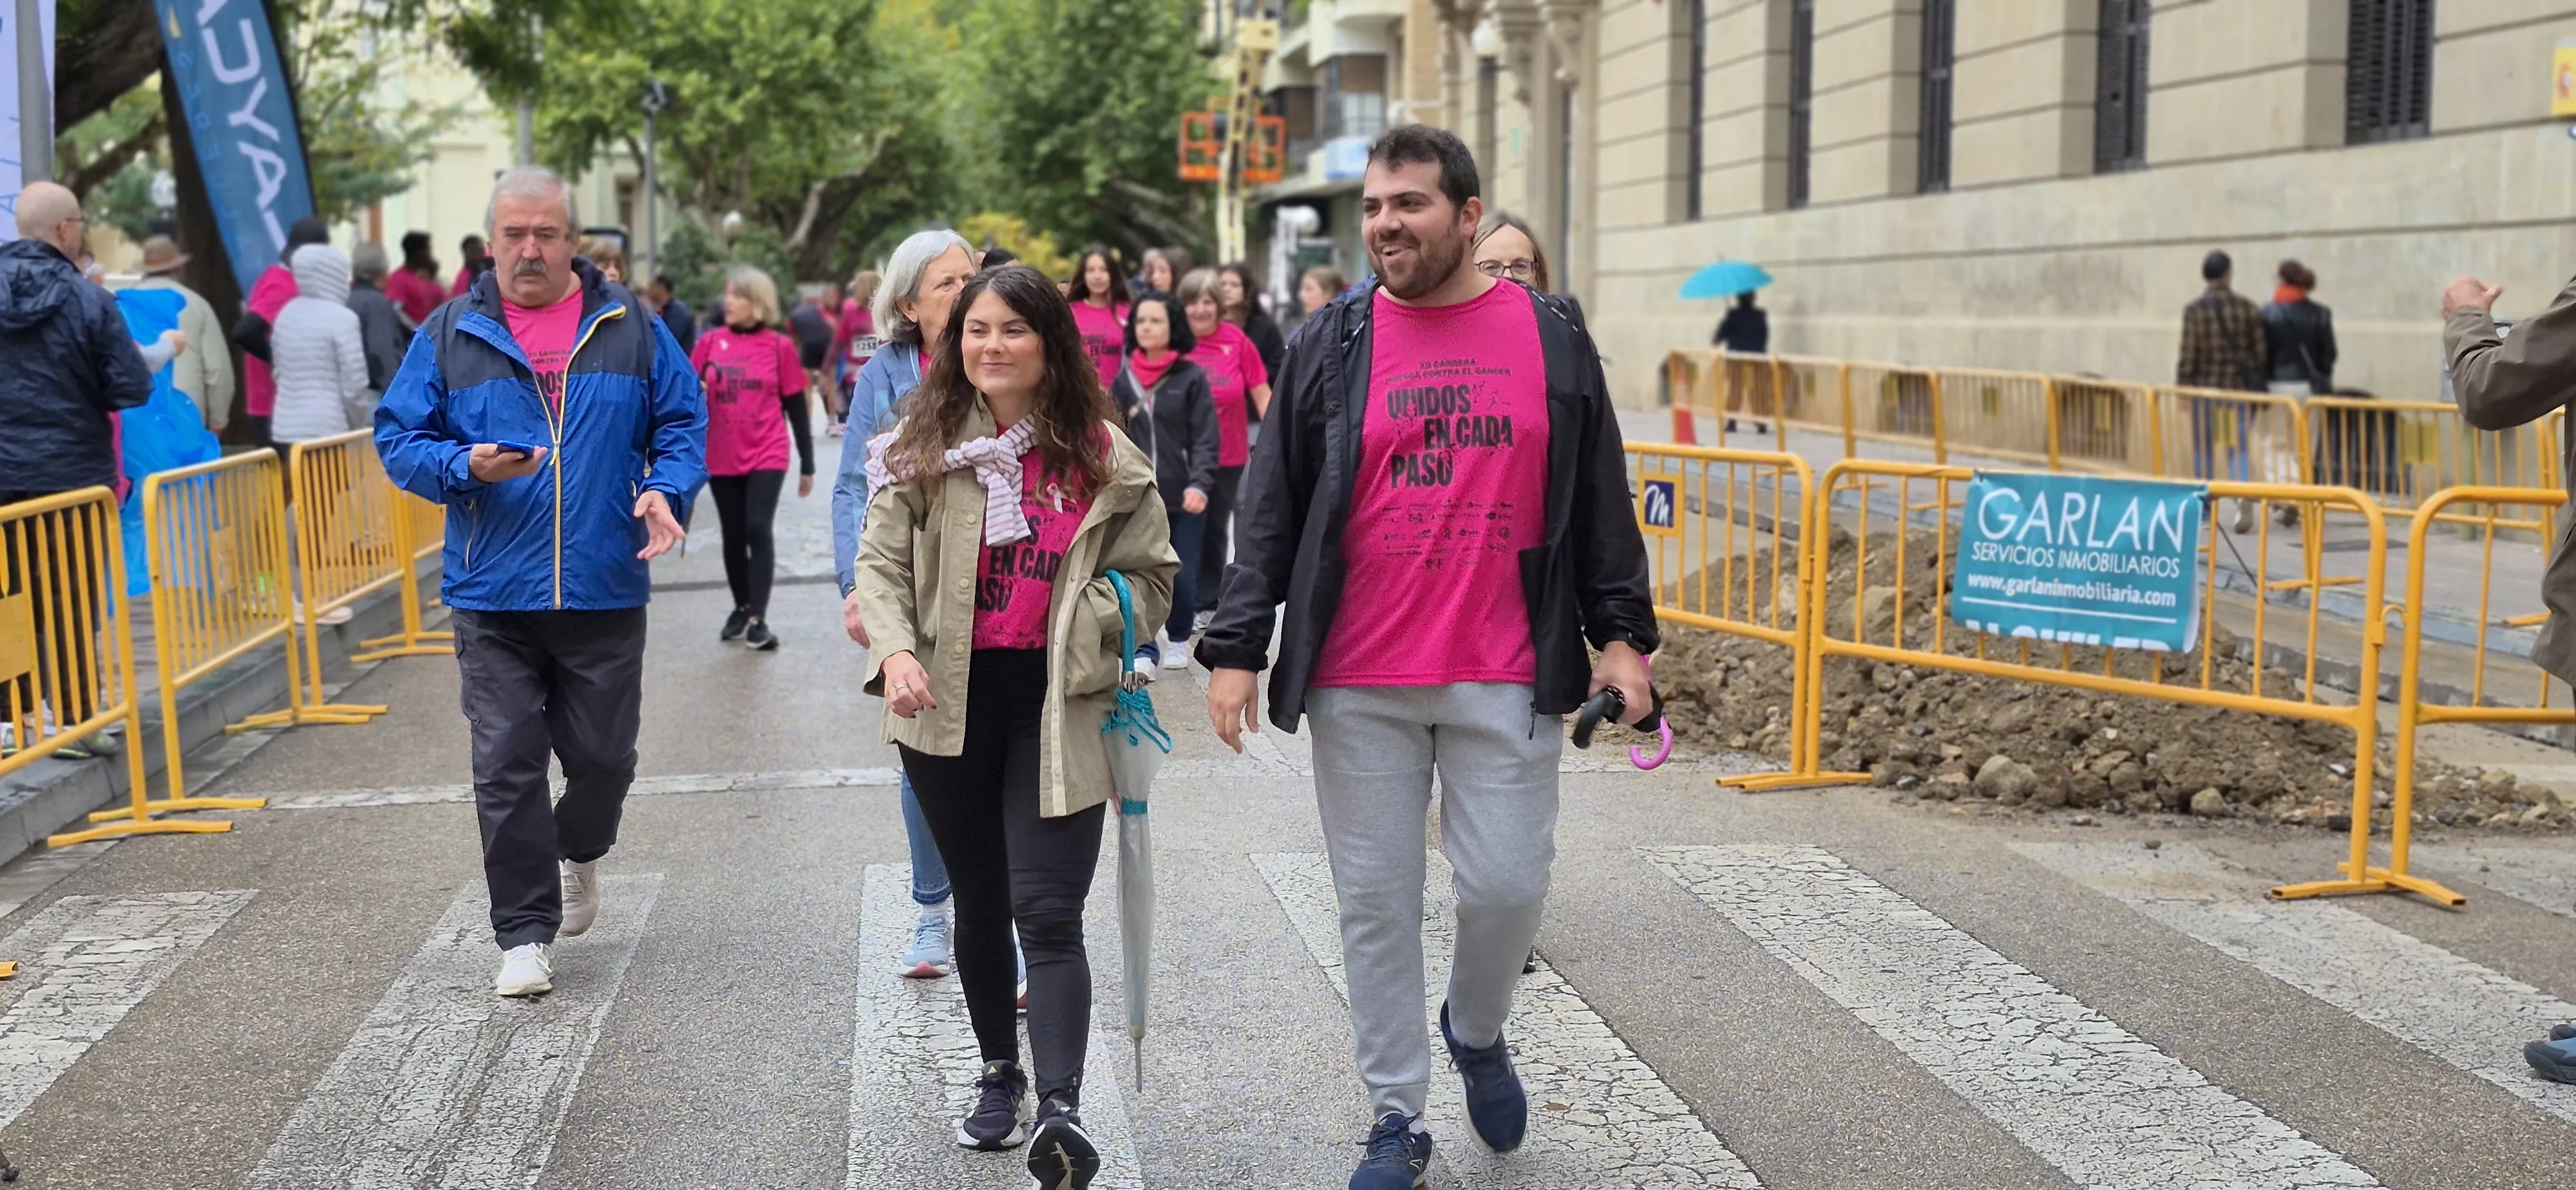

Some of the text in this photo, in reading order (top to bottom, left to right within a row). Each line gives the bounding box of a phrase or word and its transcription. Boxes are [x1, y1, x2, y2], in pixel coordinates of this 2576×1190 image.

[857, 342, 876, 351] 1258
[1387, 384, 1472, 419] UNIDOS
[1425, 415, 1513, 450] EN CADA
[1390, 452, 1454, 489] PASO
[1978, 487, 2188, 553] GARLAN
[989, 545, 1063, 582] EN CAD
[1971, 541, 2181, 578] SERVICIOS INMOBILIARIOS
[975, 576, 1014, 612] ASO
[1967, 573, 2176, 607] www.garlaninmobiliaria.com
